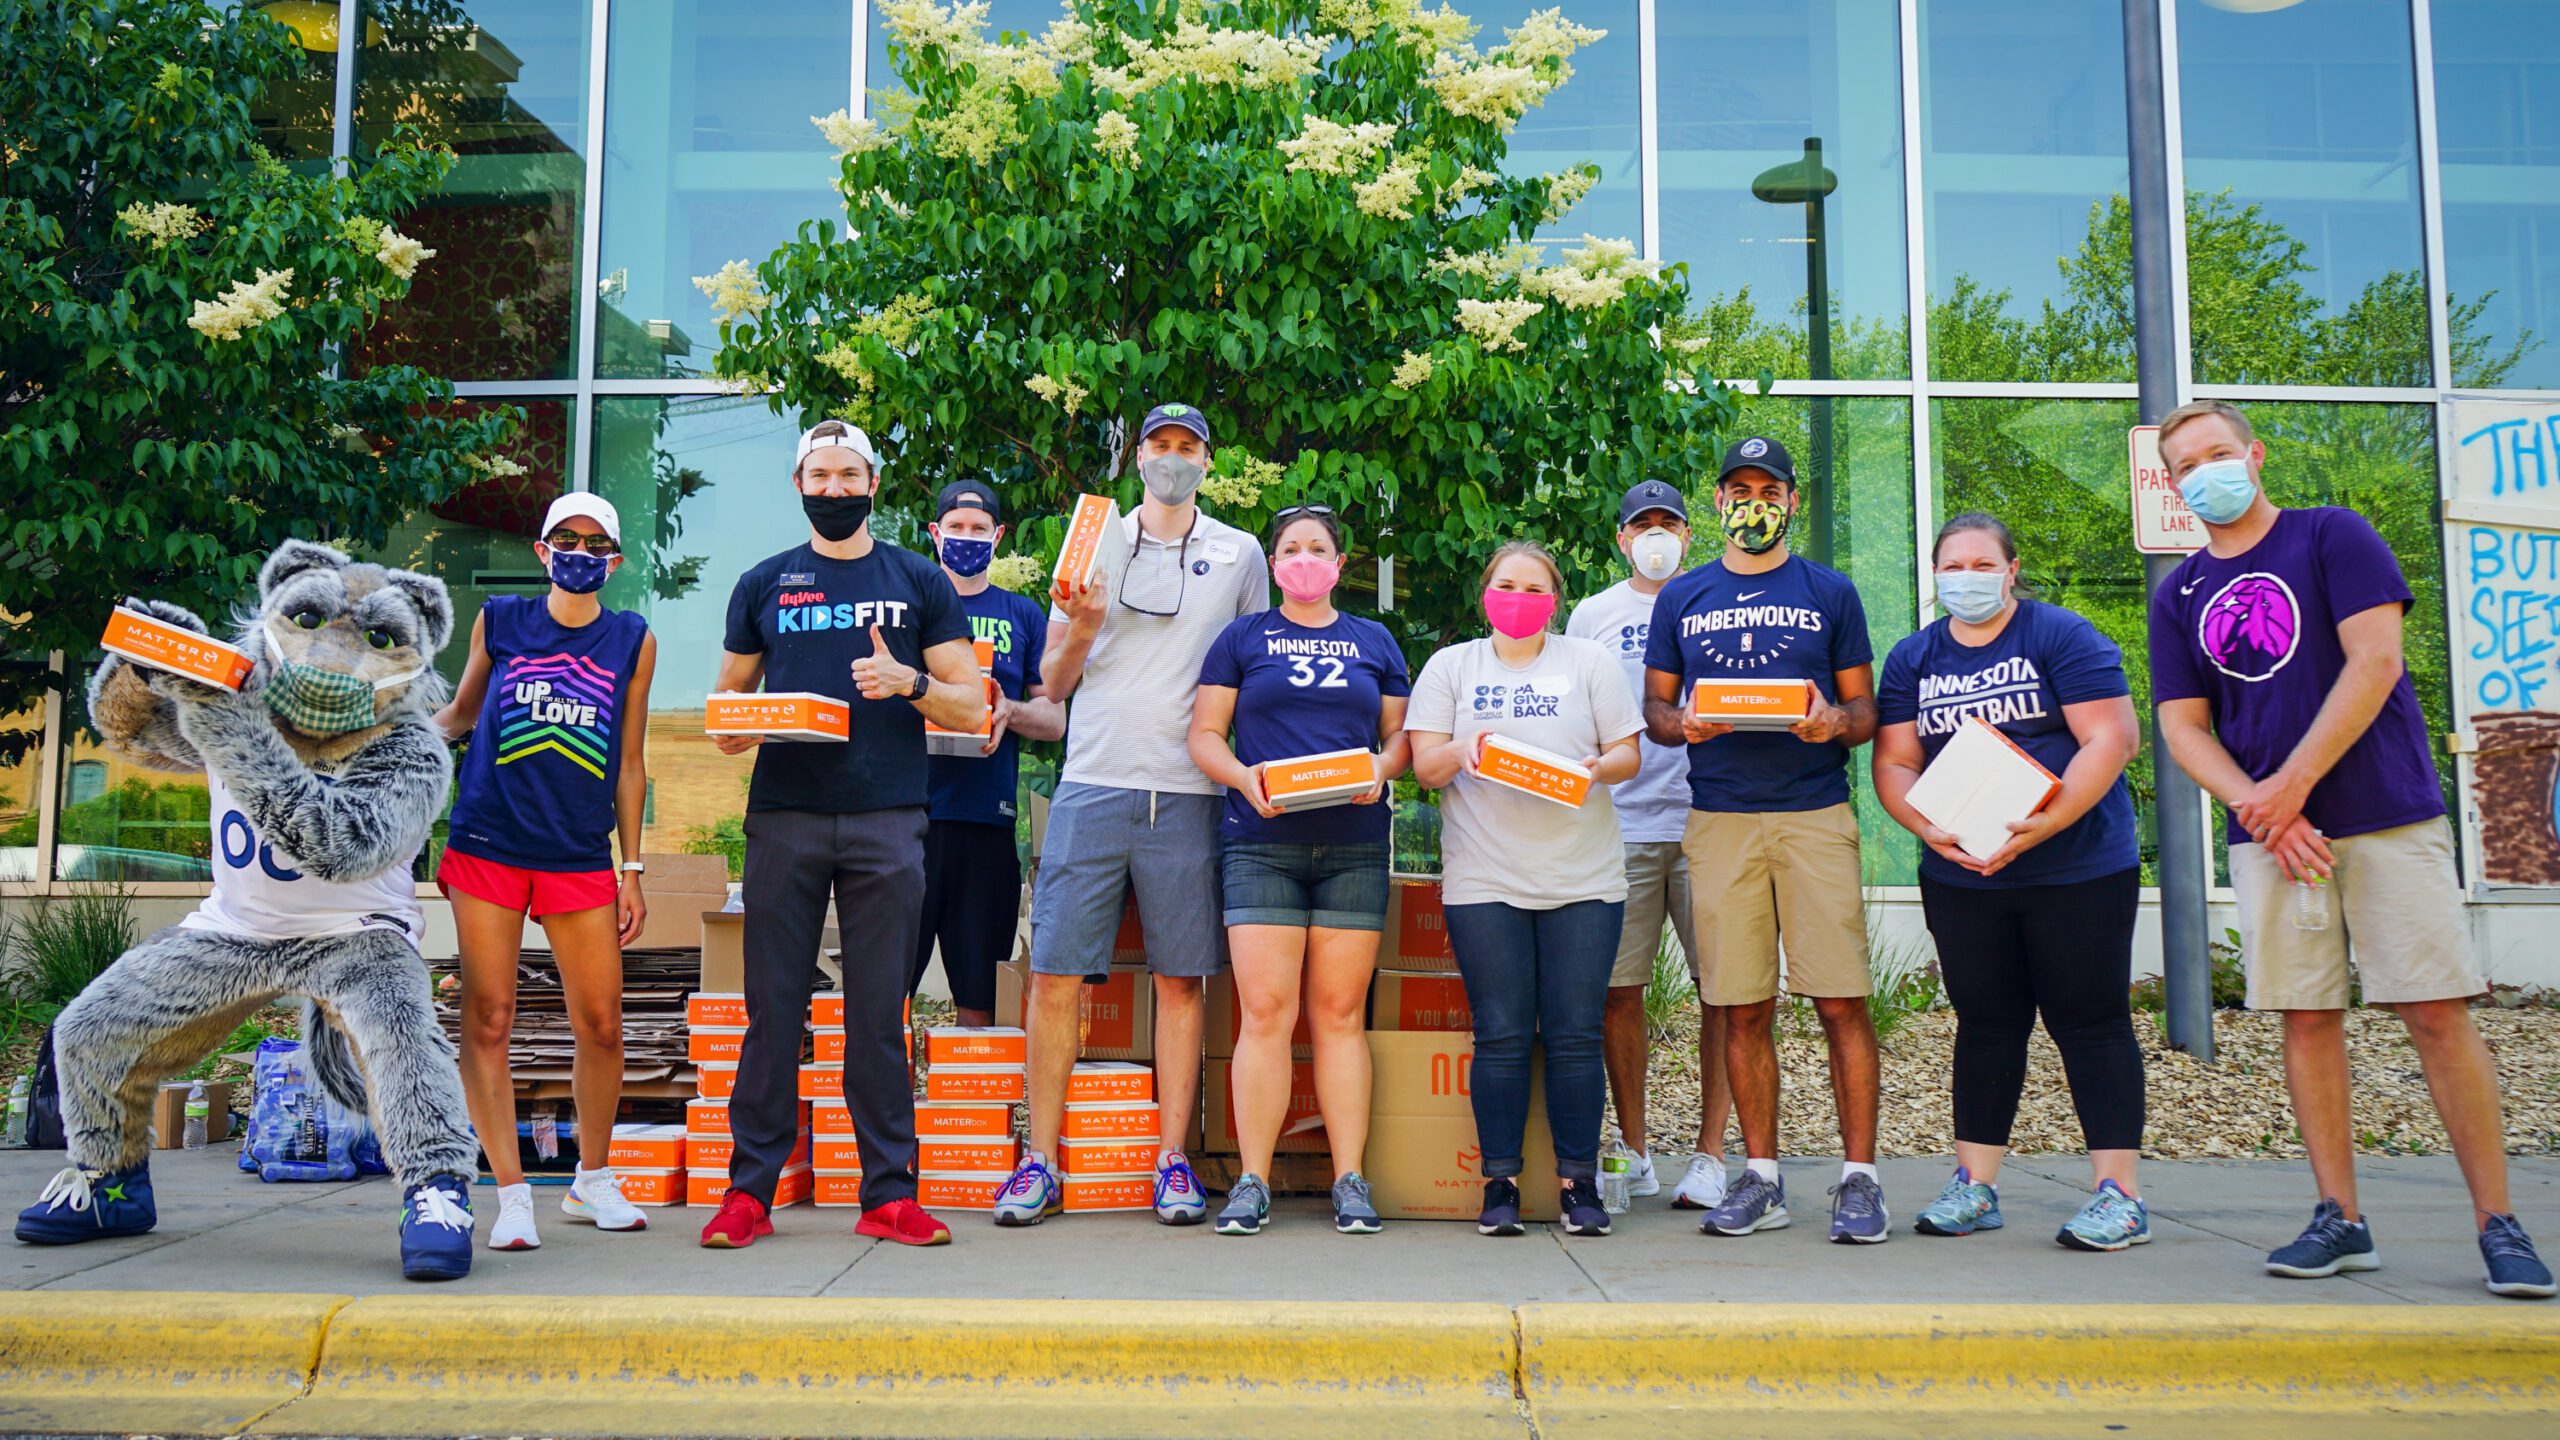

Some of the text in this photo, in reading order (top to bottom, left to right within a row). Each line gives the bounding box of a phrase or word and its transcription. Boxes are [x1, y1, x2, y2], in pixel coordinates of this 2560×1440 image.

[2163, 495, 2190, 511] FIRE
[2161, 515, 2194, 532] LANE
[1068, 519, 1090, 569] MATTER
[1682, 605, 1822, 638] TIMBERWOLVES
[127, 625, 200, 656] MATTER
[967, 615, 1012, 654] VES
[1267, 637, 1360, 659] MINNESOTA
[1700, 635, 1795, 669] BASKETBALL
[1287, 654, 1349, 688] 32
[515, 680, 552, 704] UP
[1514, 684, 1535, 694] PA
[2478, 659, 2547, 711] OF
[553, 696, 566, 704] ALL
[1513, 695, 1559, 705] GIVES
[1720, 695, 1782, 705] MATTERbox
[531, 701, 597, 727] LOVE
[720, 706, 779, 714] MATTER
[1514, 704, 1559, 718] BACK
[1291, 767, 1351, 782] MATTERbox
[1499, 757, 1559, 782] MATTER
[1416, 913, 1442, 930] YOU
[1087, 1003, 1119, 1020] TTER
[1414, 1009, 1441, 1027] YOU
[710, 1044, 742, 1052] MATTE
[953, 1046, 1006, 1054] MATTERbox
[933, 1118, 987, 1127] MATTERbox
[1081, 1116, 1136, 1124] MATTER
[1083, 1151, 1137, 1160] MATTER
[930, 1186, 983, 1194] MATTER
[1077, 1187, 1131, 1196] MATTER
[1434, 1180, 1483, 1188] MATT
